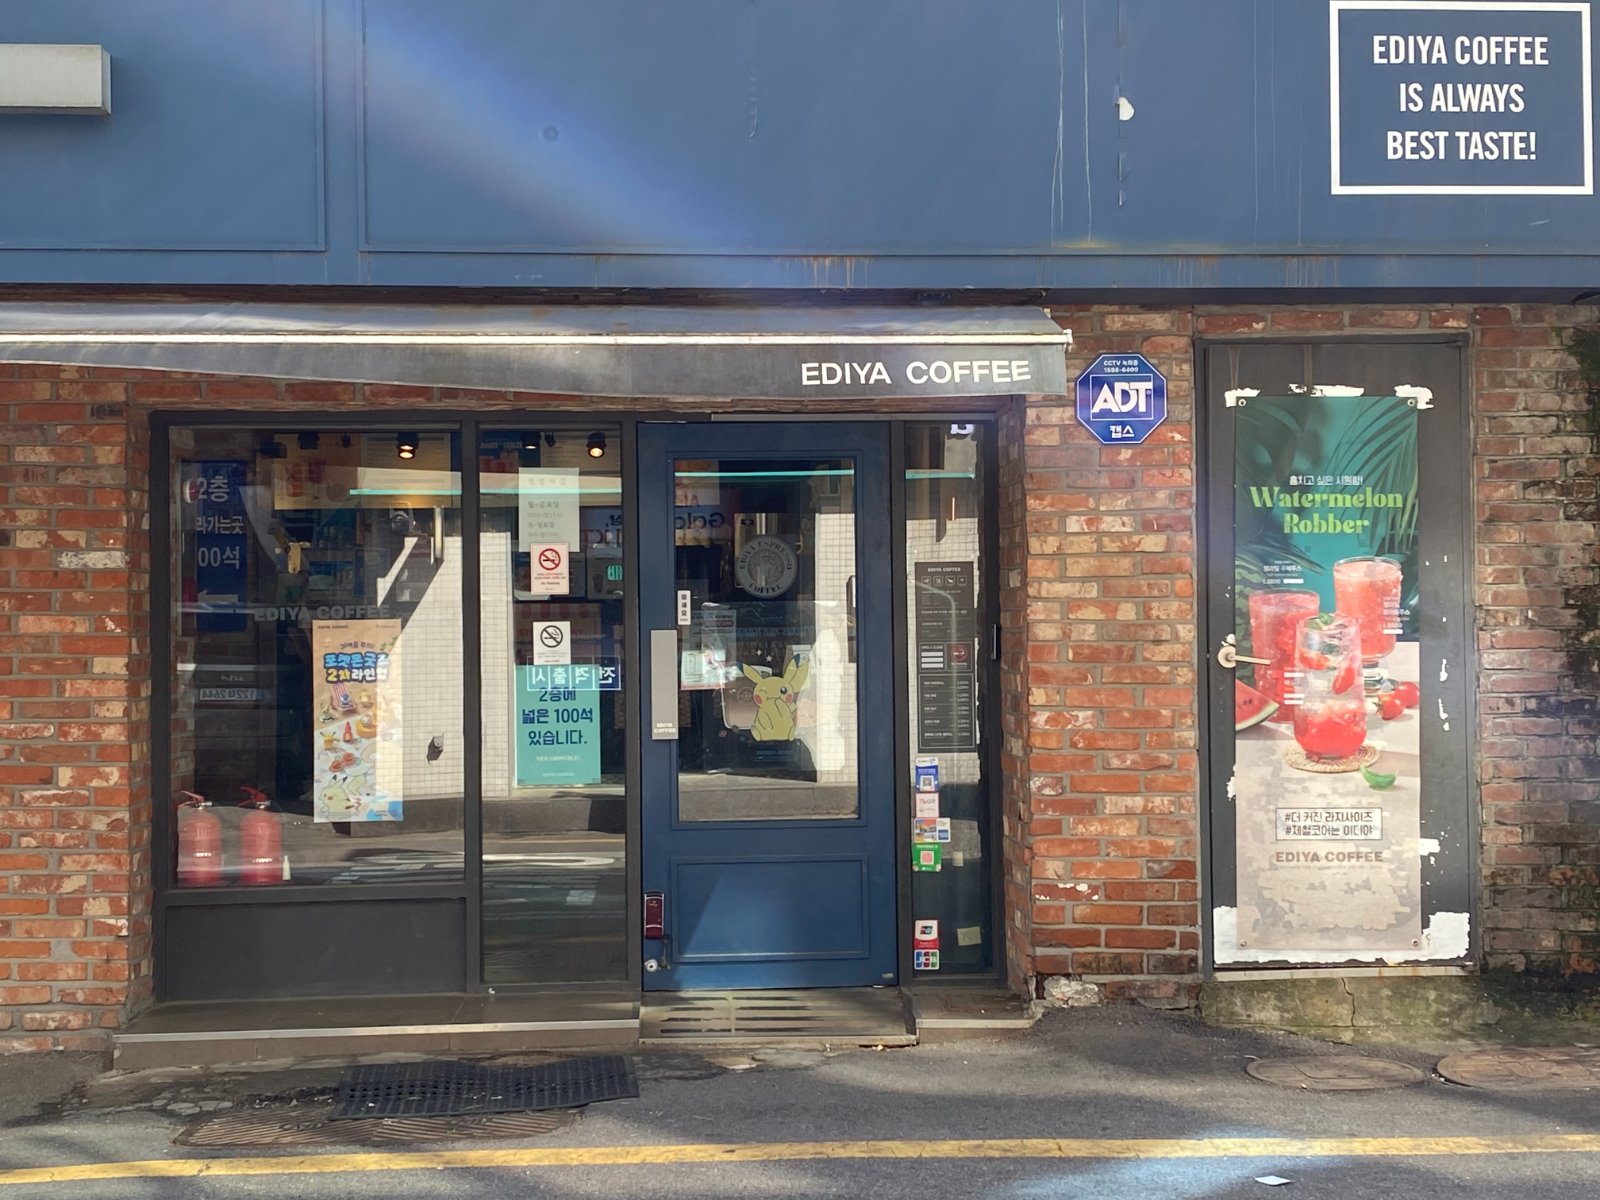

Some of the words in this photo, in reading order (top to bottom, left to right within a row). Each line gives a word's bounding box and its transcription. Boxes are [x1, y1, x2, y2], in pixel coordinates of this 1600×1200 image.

[1373, 35, 1448, 64] EDIYA
[1455, 35, 1549, 65] COFFEE
[1400, 82, 1424, 112] IS
[1430, 83, 1525, 113] ALWAYS
[1387, 130, 1449, 160] BEST
[1455, 131, 1537, 161] TASTE!
[801, 362, 892, 386] EDIYA
[905, 360, 1032, 384] COFFEE
[1092, 381, 1153, 413] ADT
[1110, 425, 1135, 438] 캡스
[196, 475, 230, 502] 2층
[1249, 486, 1403, 508] Watermelon
[1283, 513, 1370, 534] Robber
[254, 606, 310, 622] EDIYA
[316, 604, 390, 619] COFFEE
[538, 686, 577, 702] 2층에
[522, 708, 549, 724] 넓은
[554, 708, 593, 724] 100석
[528, 730, 588, 746] 있습니다.
[1284, 811, 1301, 822] #더
[1303, 811, 1322, 822] 커진
[1325, 811, 1373, 822] 라지사이즈
[1343, 825, 1373, 836] 이디야
[1275, 851, 1320, 862] EDIYA
[1325, 851, 1384, 862] COFFEE
